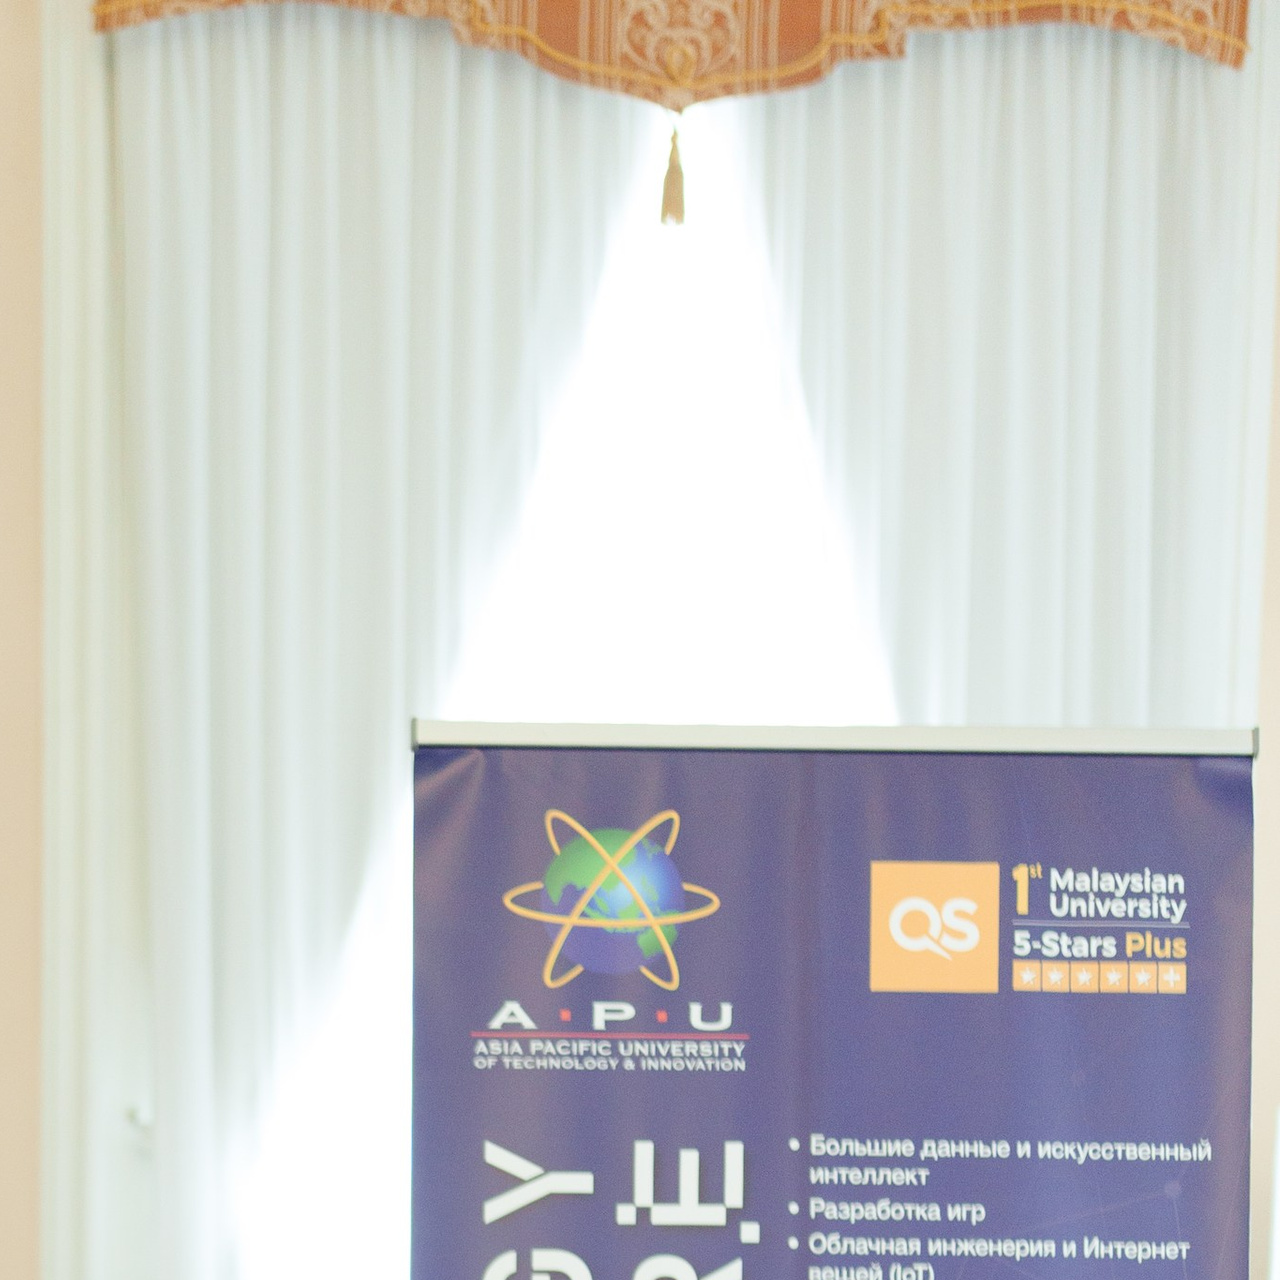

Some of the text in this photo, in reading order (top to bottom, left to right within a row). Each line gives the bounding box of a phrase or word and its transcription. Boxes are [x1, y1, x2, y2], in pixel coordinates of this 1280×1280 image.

[1050, 867, 1185, 898] Malaysian
[1049, 892, 1187, 924] University
[888, 895, 980, 961] QS
[1013, 929, 1188, 959] 5-Stars Plus
[474, 1039, 746, 1058] ASIA PACIFIC UNIVERSITY
[474, 1056, 747, 1072] OF TECHNOLOGY & INNOVATION
[810, 1133, 1212, 1163] Большие данные и искусственный
[810, 1166, 930, 1187] интеллект
[809, 1197, 986, 1226] Разработка игр
[808, 1232, 1191, 1263] Облачная инженерия и Интернет
